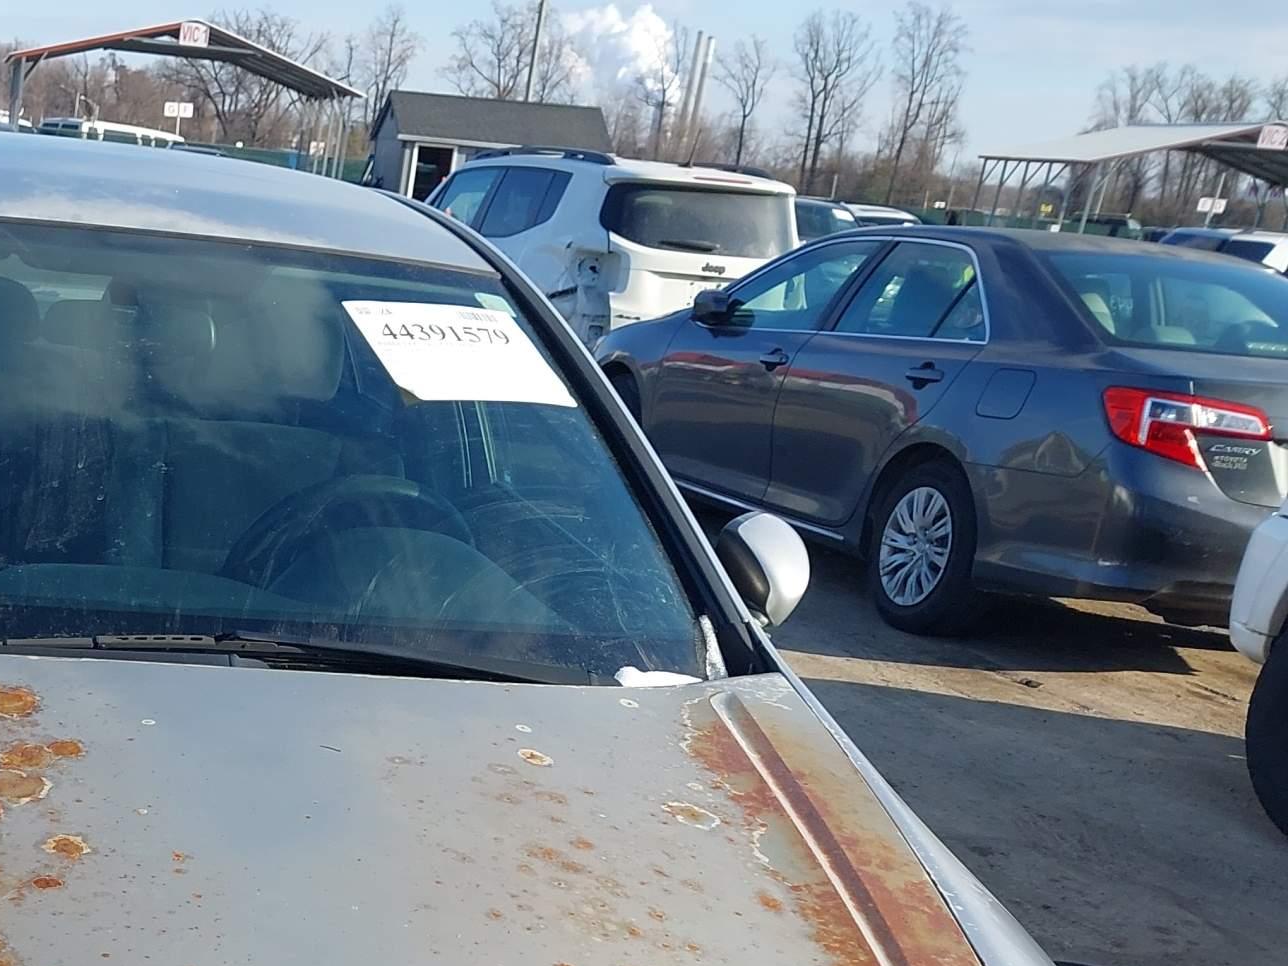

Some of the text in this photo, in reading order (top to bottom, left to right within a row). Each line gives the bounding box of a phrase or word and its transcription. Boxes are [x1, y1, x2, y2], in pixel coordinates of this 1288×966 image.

[182, 25, 201, 42] VIC
[702, 262, 726, 276] Jeep
[381, 322, 510, 345] 44391579
